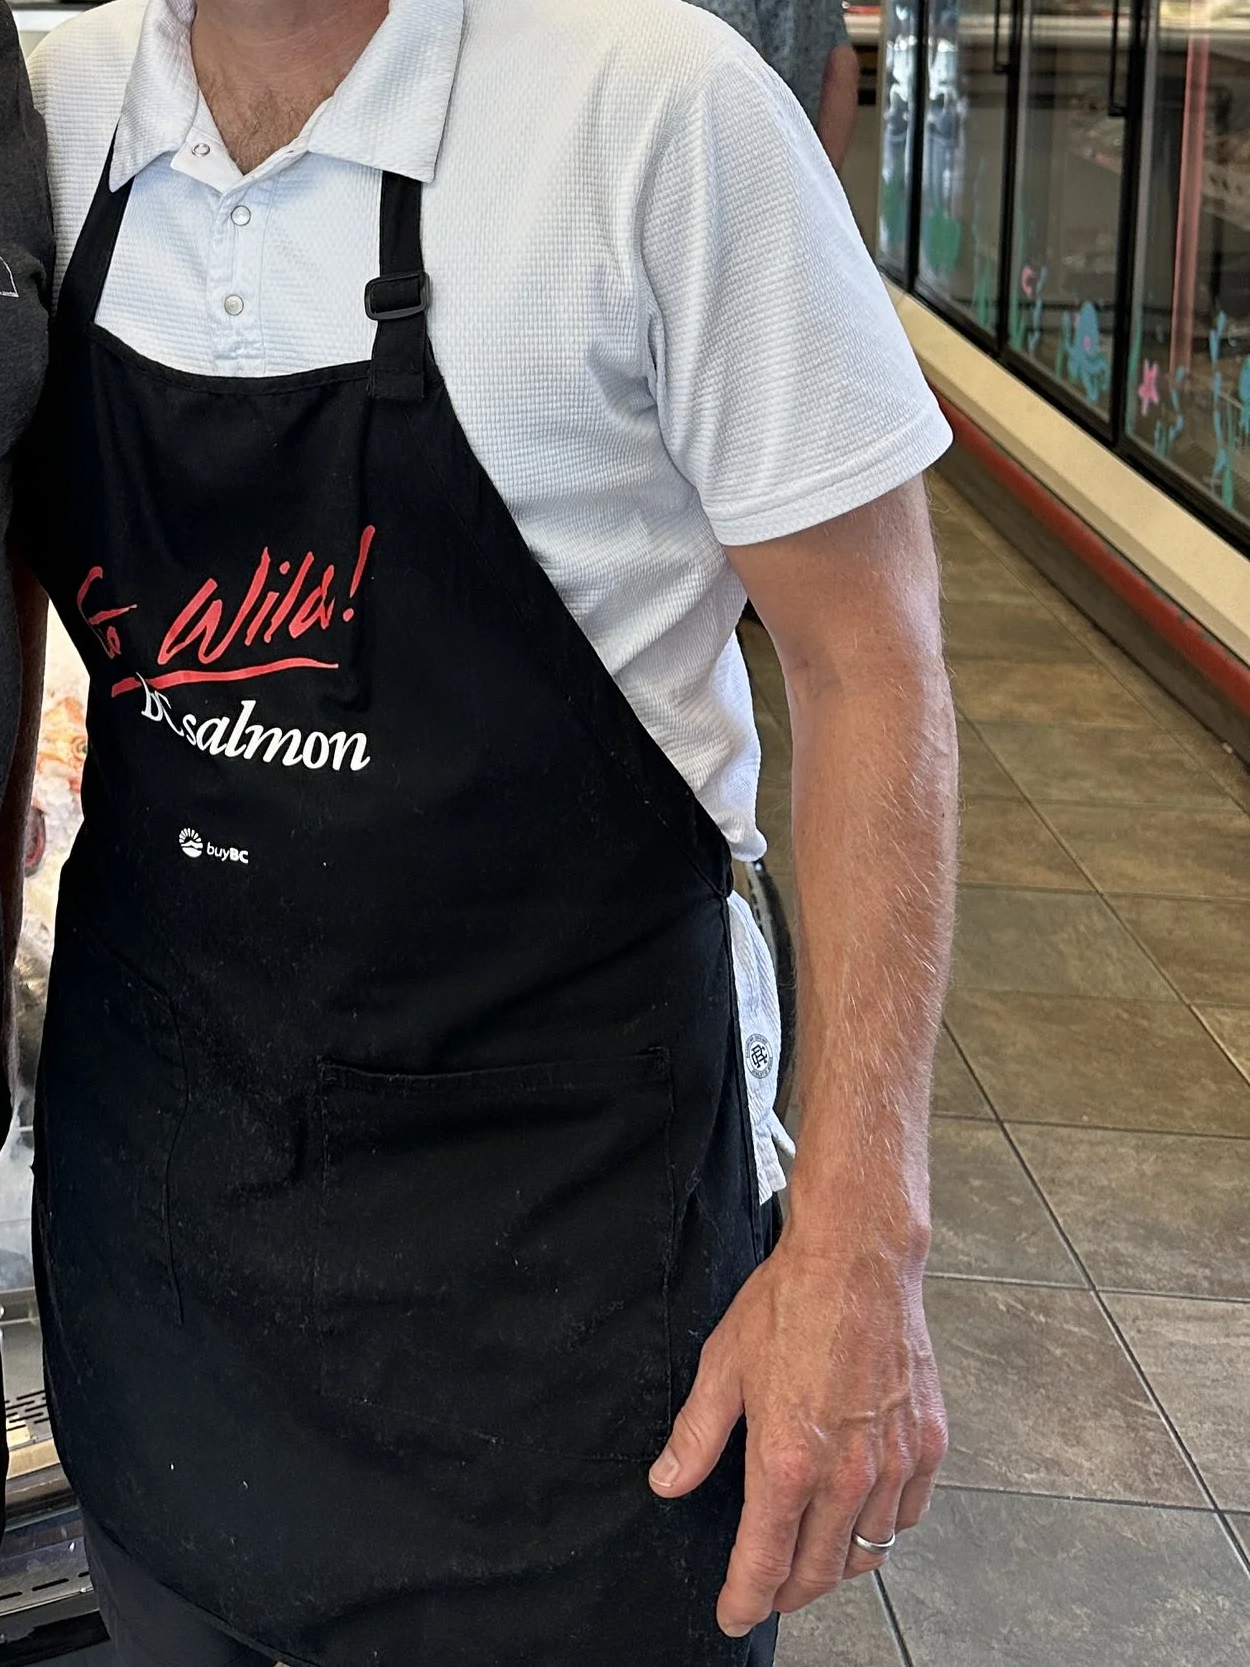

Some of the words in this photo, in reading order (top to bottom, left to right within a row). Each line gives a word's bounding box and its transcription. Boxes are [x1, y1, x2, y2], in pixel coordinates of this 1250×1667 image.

[157, 525, 376, 665] Wild!
[182, 700, 371, 772] salmon
[206, 841, 249, 864] buyBC
